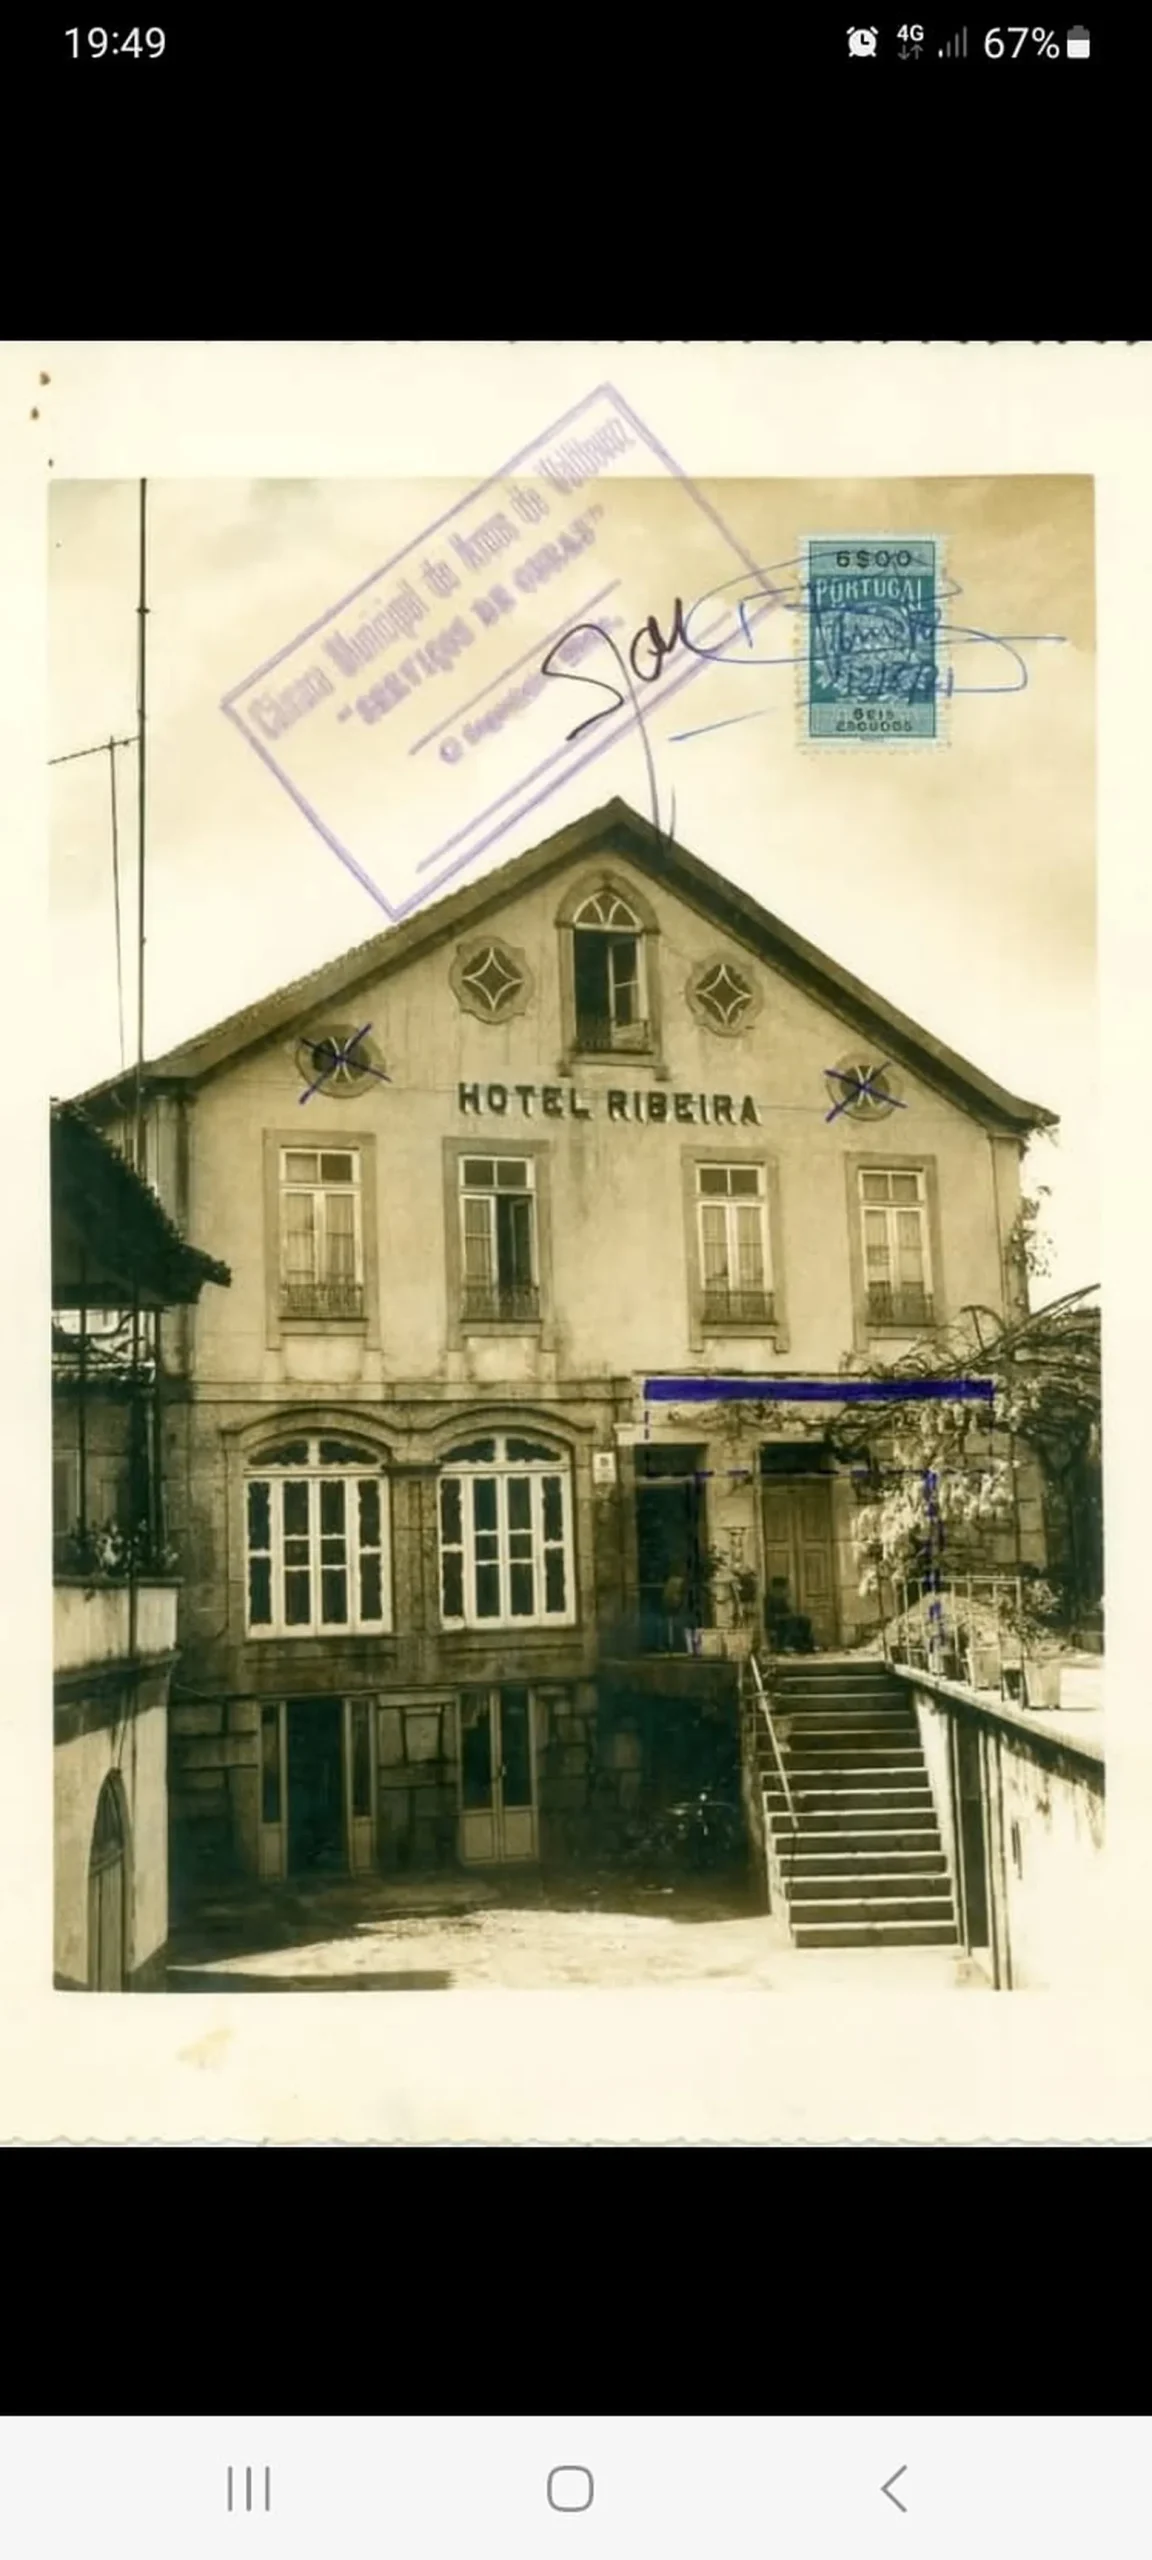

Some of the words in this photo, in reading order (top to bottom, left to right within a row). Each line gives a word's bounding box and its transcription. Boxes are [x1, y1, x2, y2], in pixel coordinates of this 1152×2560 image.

[65, 27, 166, 58] 19:49
[897, 24, 924, 42] 4G
[984, 27, 1060, 59] 67%
[457, 1082, 593, 1121] HOTEL
[606, 1089, 763, 1126] RIBEIRA
